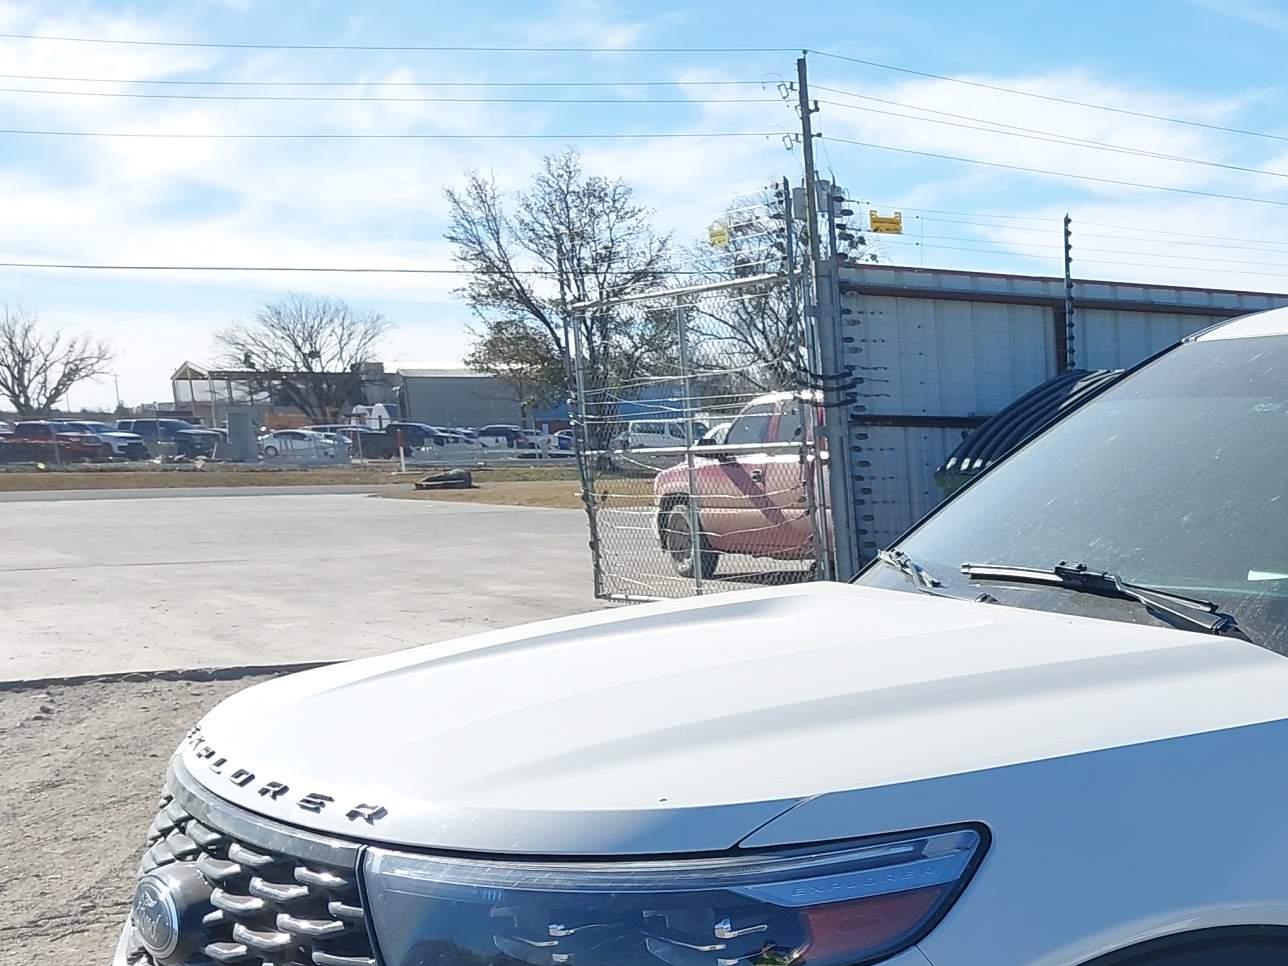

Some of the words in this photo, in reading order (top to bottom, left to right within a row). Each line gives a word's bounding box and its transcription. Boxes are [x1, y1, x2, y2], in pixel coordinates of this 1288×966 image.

[187, 724, 389, 826] EXPLORER
[791, 867, 936, 897] EXPLORER
[137, 890, 161, 942] Ford
